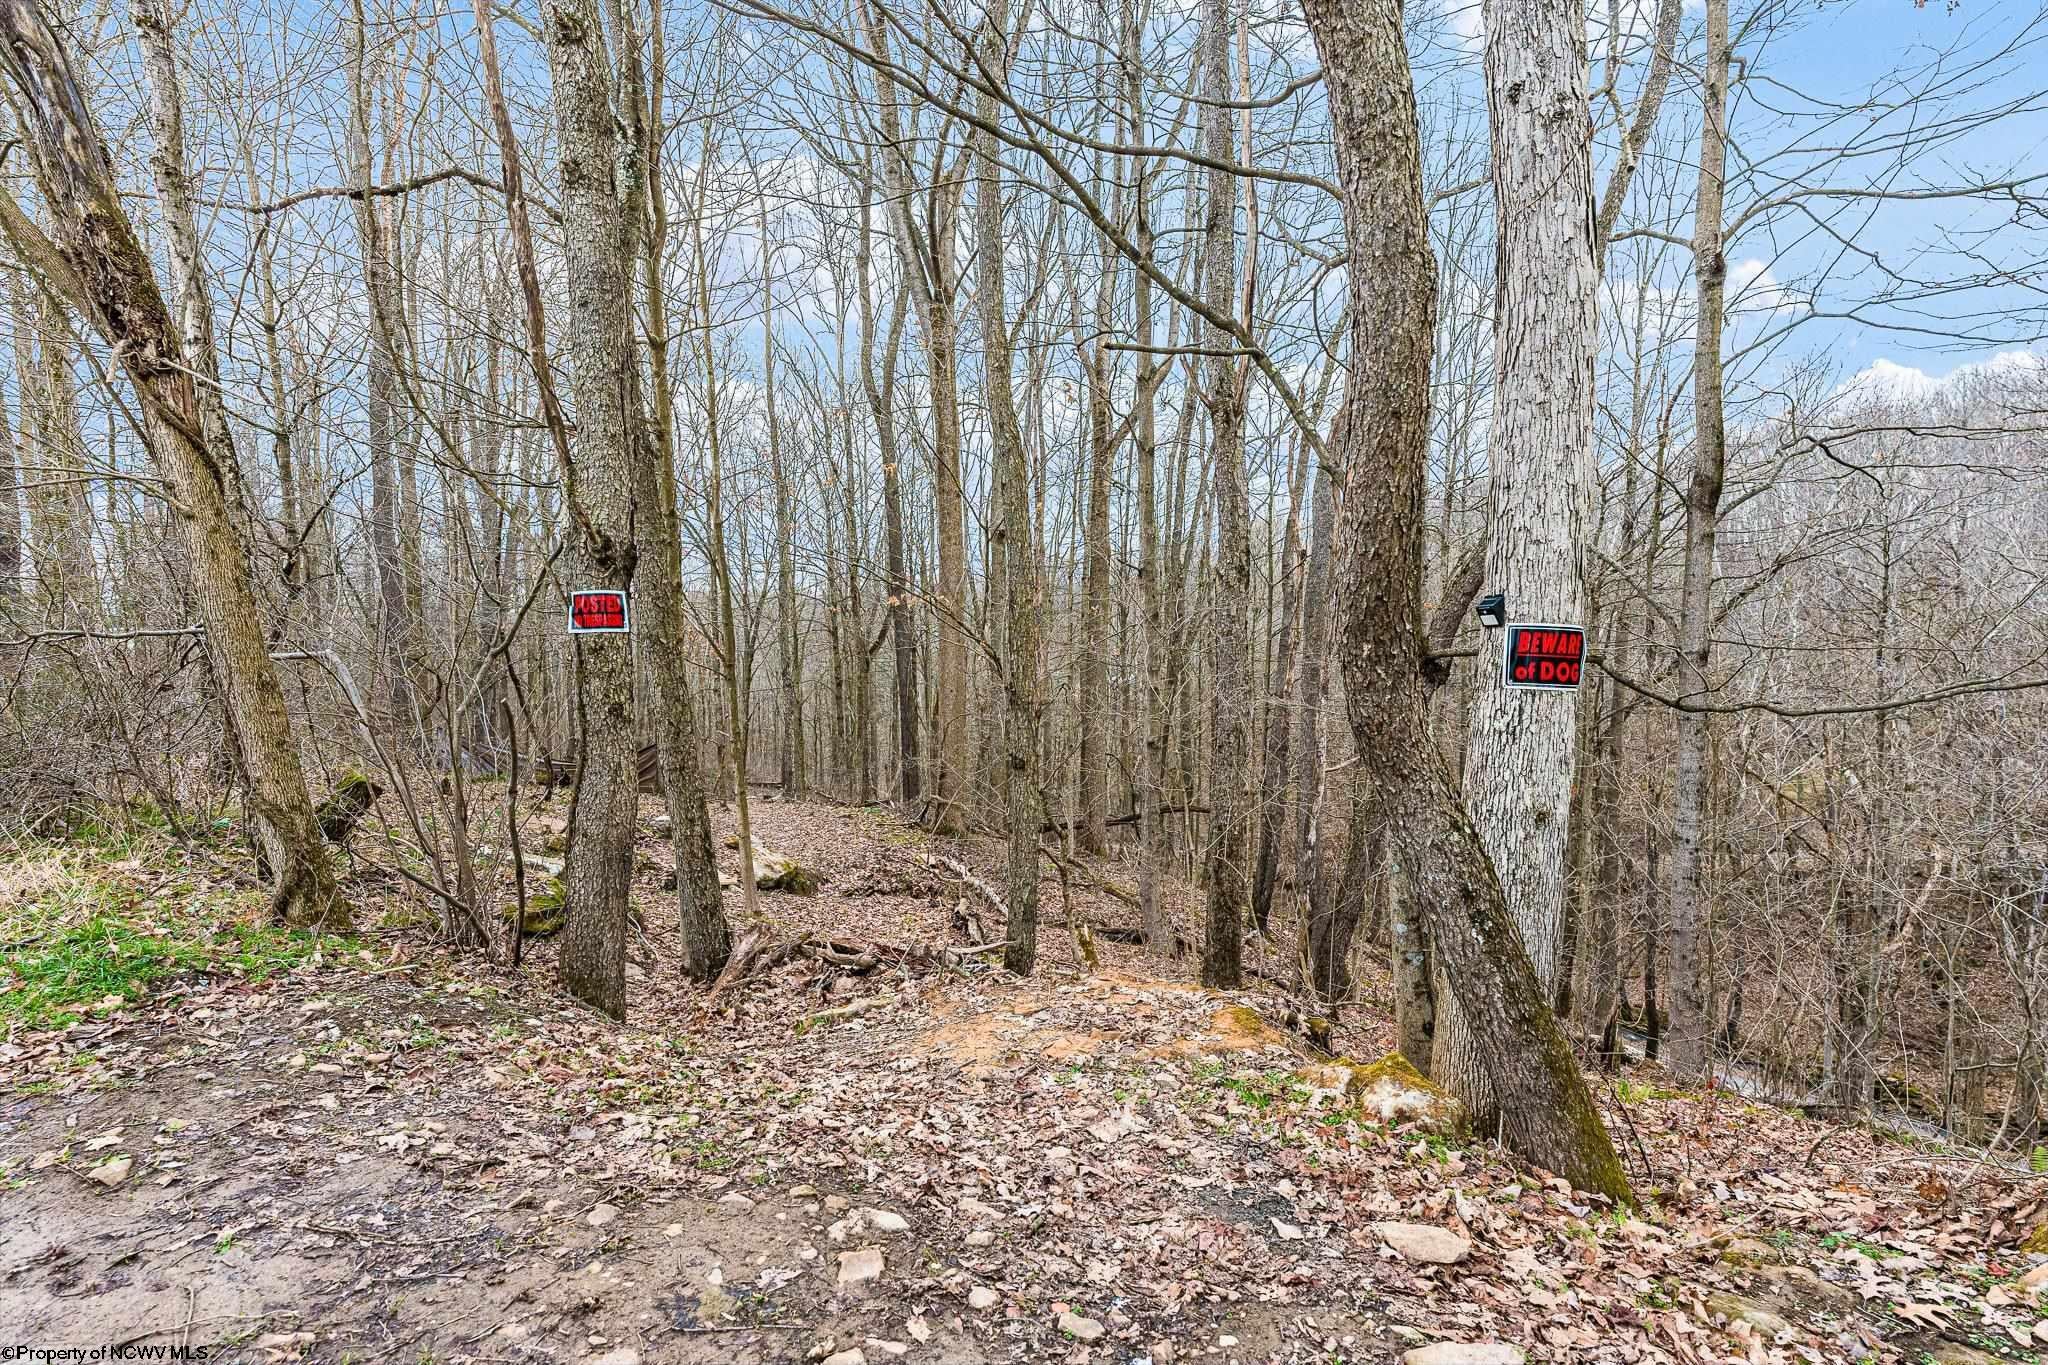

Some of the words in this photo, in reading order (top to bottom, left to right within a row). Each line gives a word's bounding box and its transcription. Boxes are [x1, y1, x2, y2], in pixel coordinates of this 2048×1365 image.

[574, 595, 621, 613] POSTED
[1515, 661, 1536, 681] of
[1540, 661, 1579, 682] DOG
